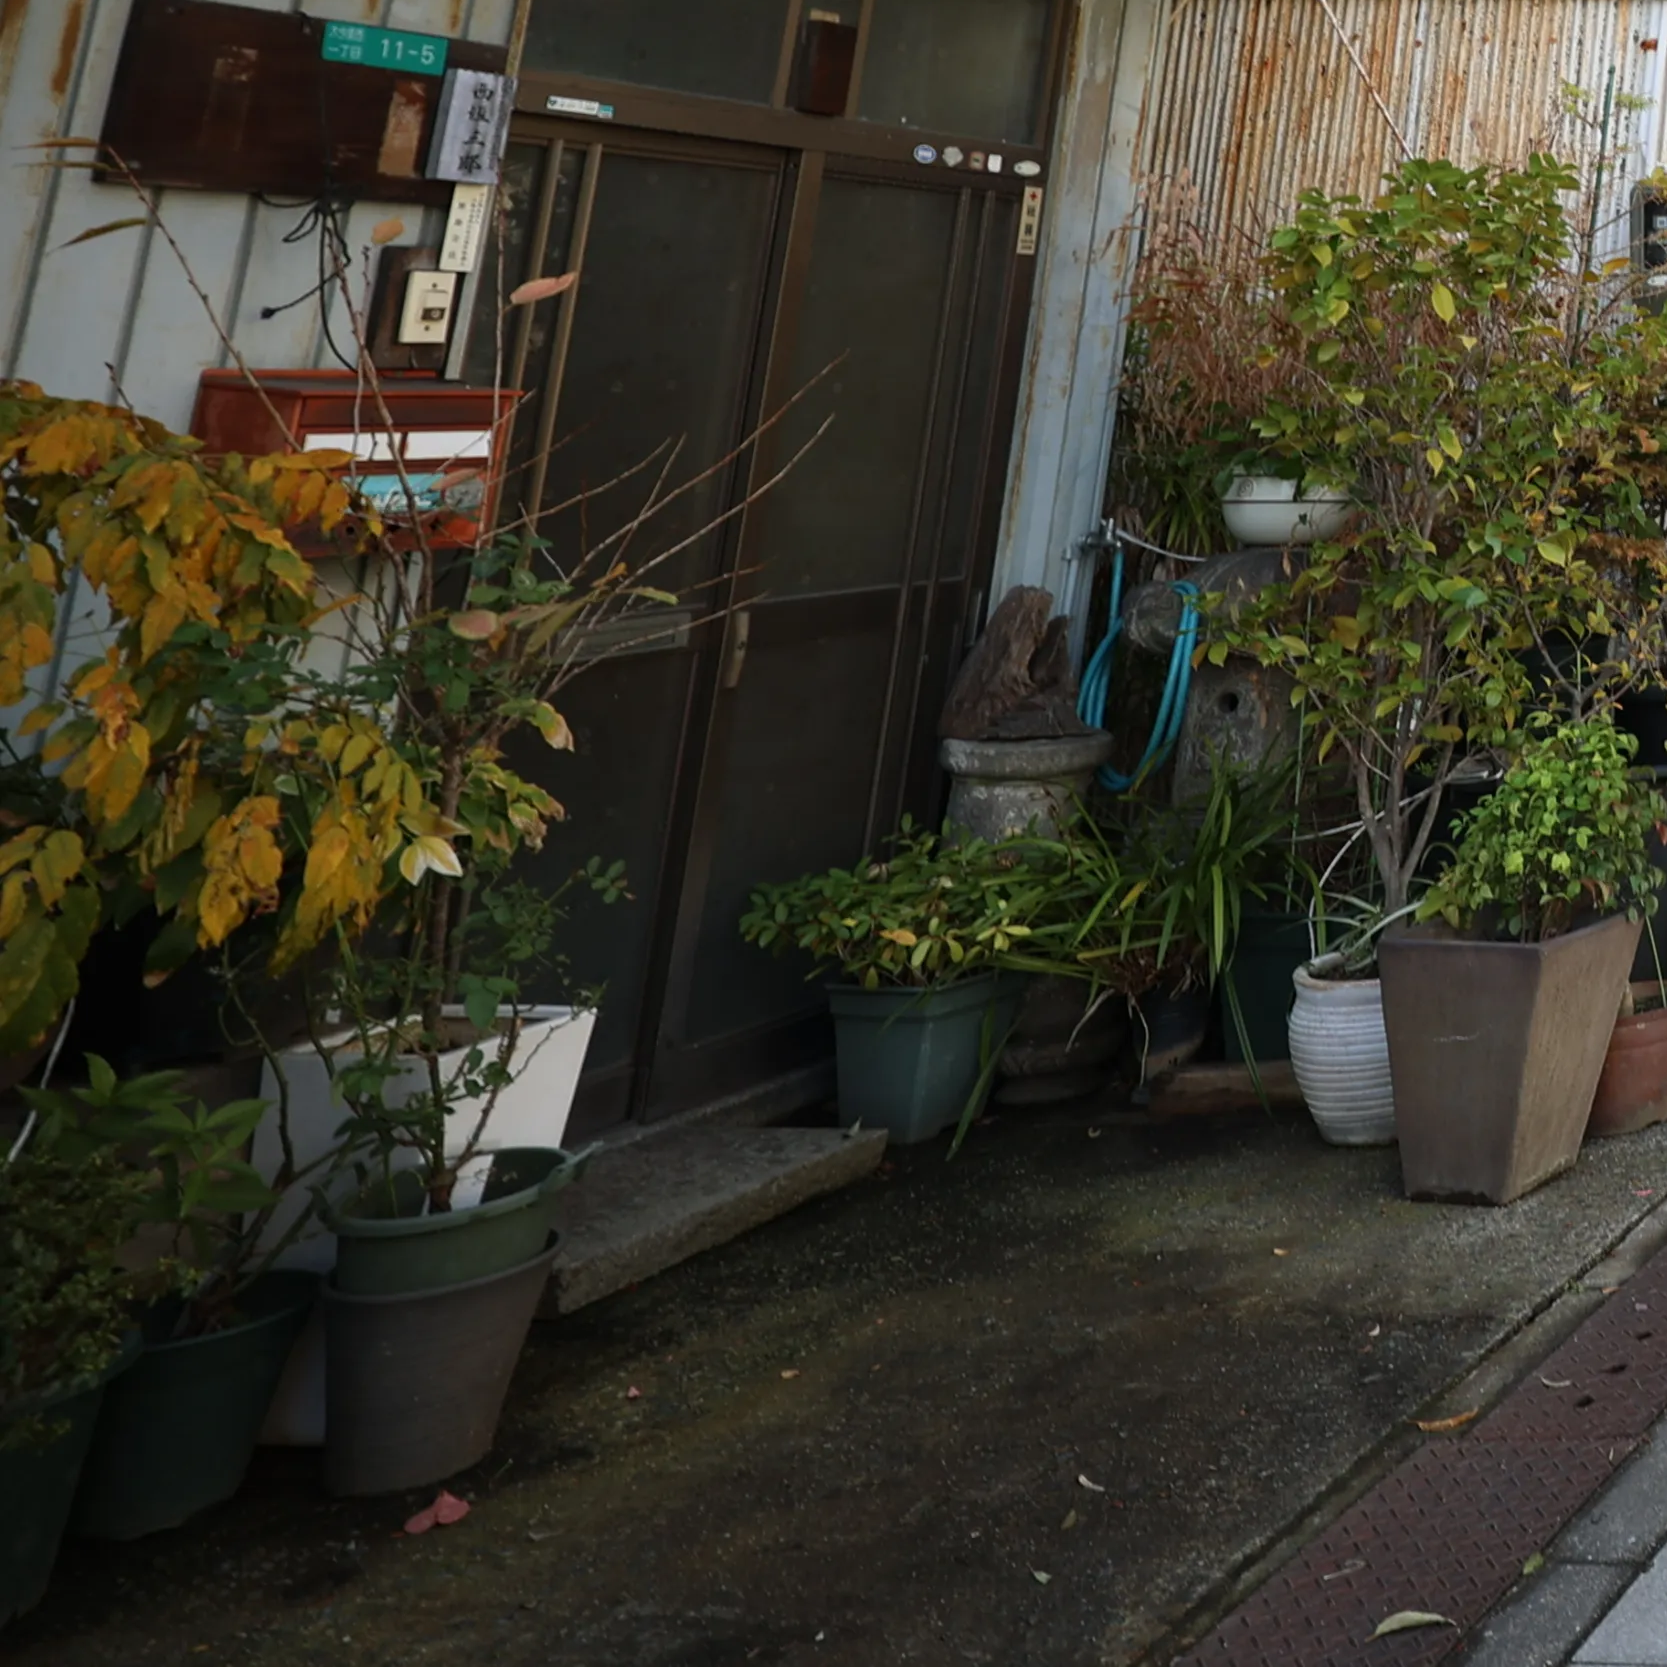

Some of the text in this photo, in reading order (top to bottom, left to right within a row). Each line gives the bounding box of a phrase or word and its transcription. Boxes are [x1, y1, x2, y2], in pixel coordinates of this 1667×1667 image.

[327, 44, 362, 61] 一丁目
[380, 38, 436, 65] 11-5
